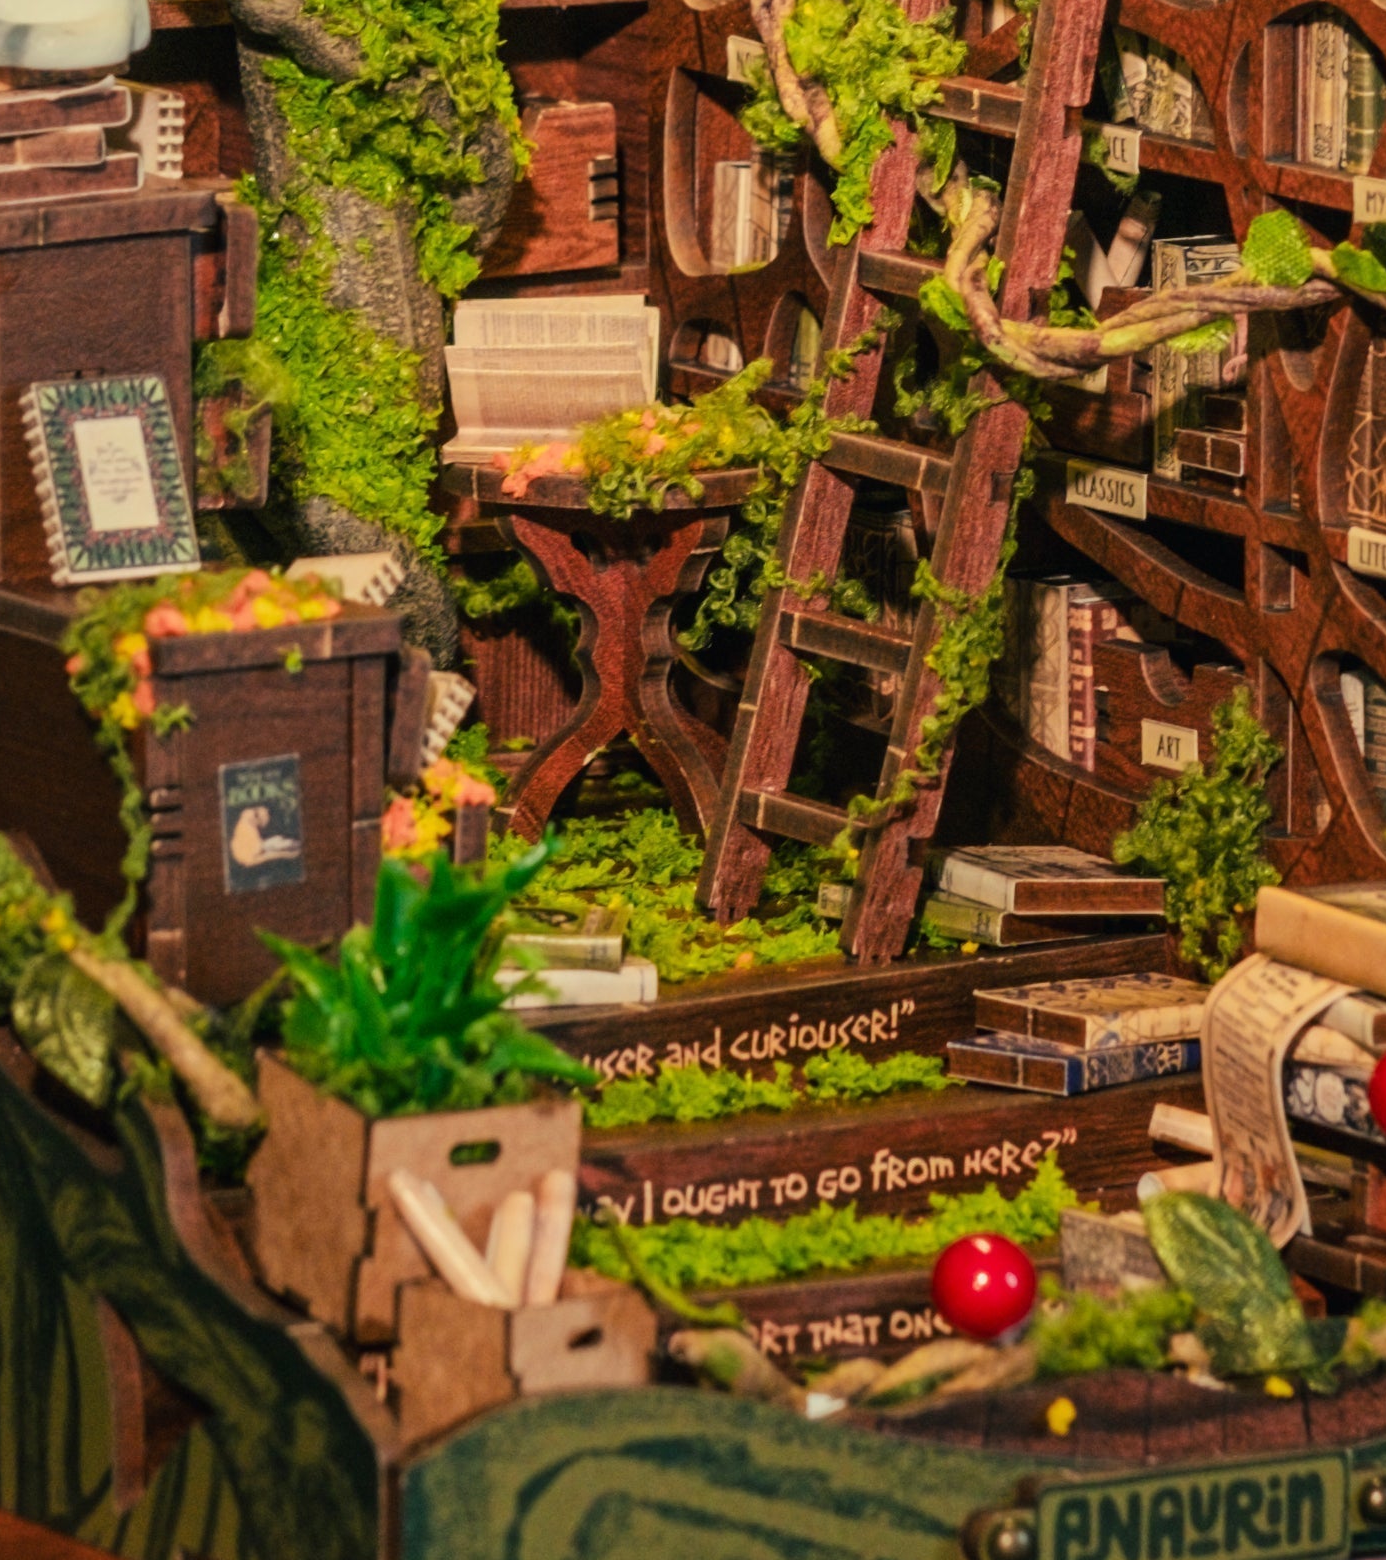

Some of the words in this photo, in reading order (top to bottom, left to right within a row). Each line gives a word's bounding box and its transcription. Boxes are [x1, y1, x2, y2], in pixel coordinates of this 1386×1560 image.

[1073, 471, 1136, 508] CLASSICS
[1157, 734, 1180, 759] ART
[662, 1180, 762, 1217] OUGHT
[770, 1173, 807, 1204] TO
[816, 1165, 861, 1200] GO
